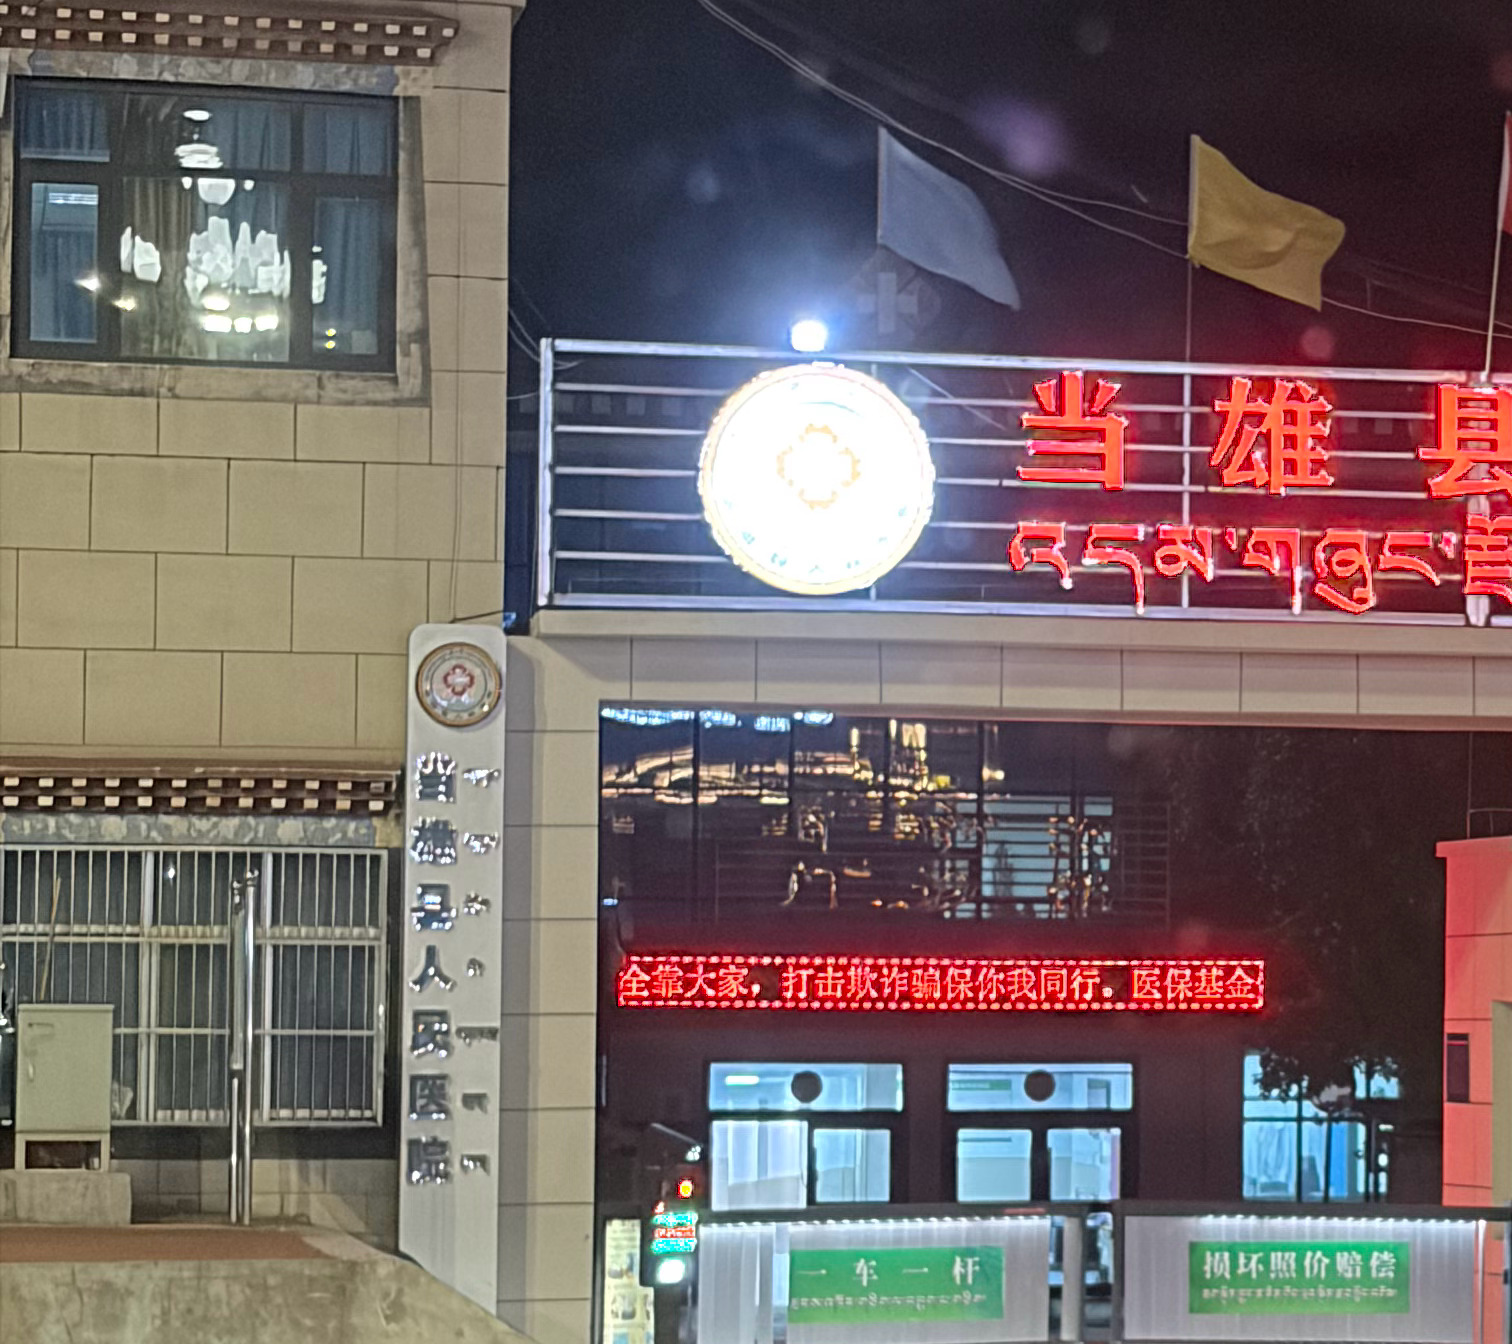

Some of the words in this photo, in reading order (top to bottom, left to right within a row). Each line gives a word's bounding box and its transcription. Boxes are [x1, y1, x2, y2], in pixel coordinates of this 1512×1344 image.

[1203, 1250, 1397, 1280] 损坏照价赔偿
